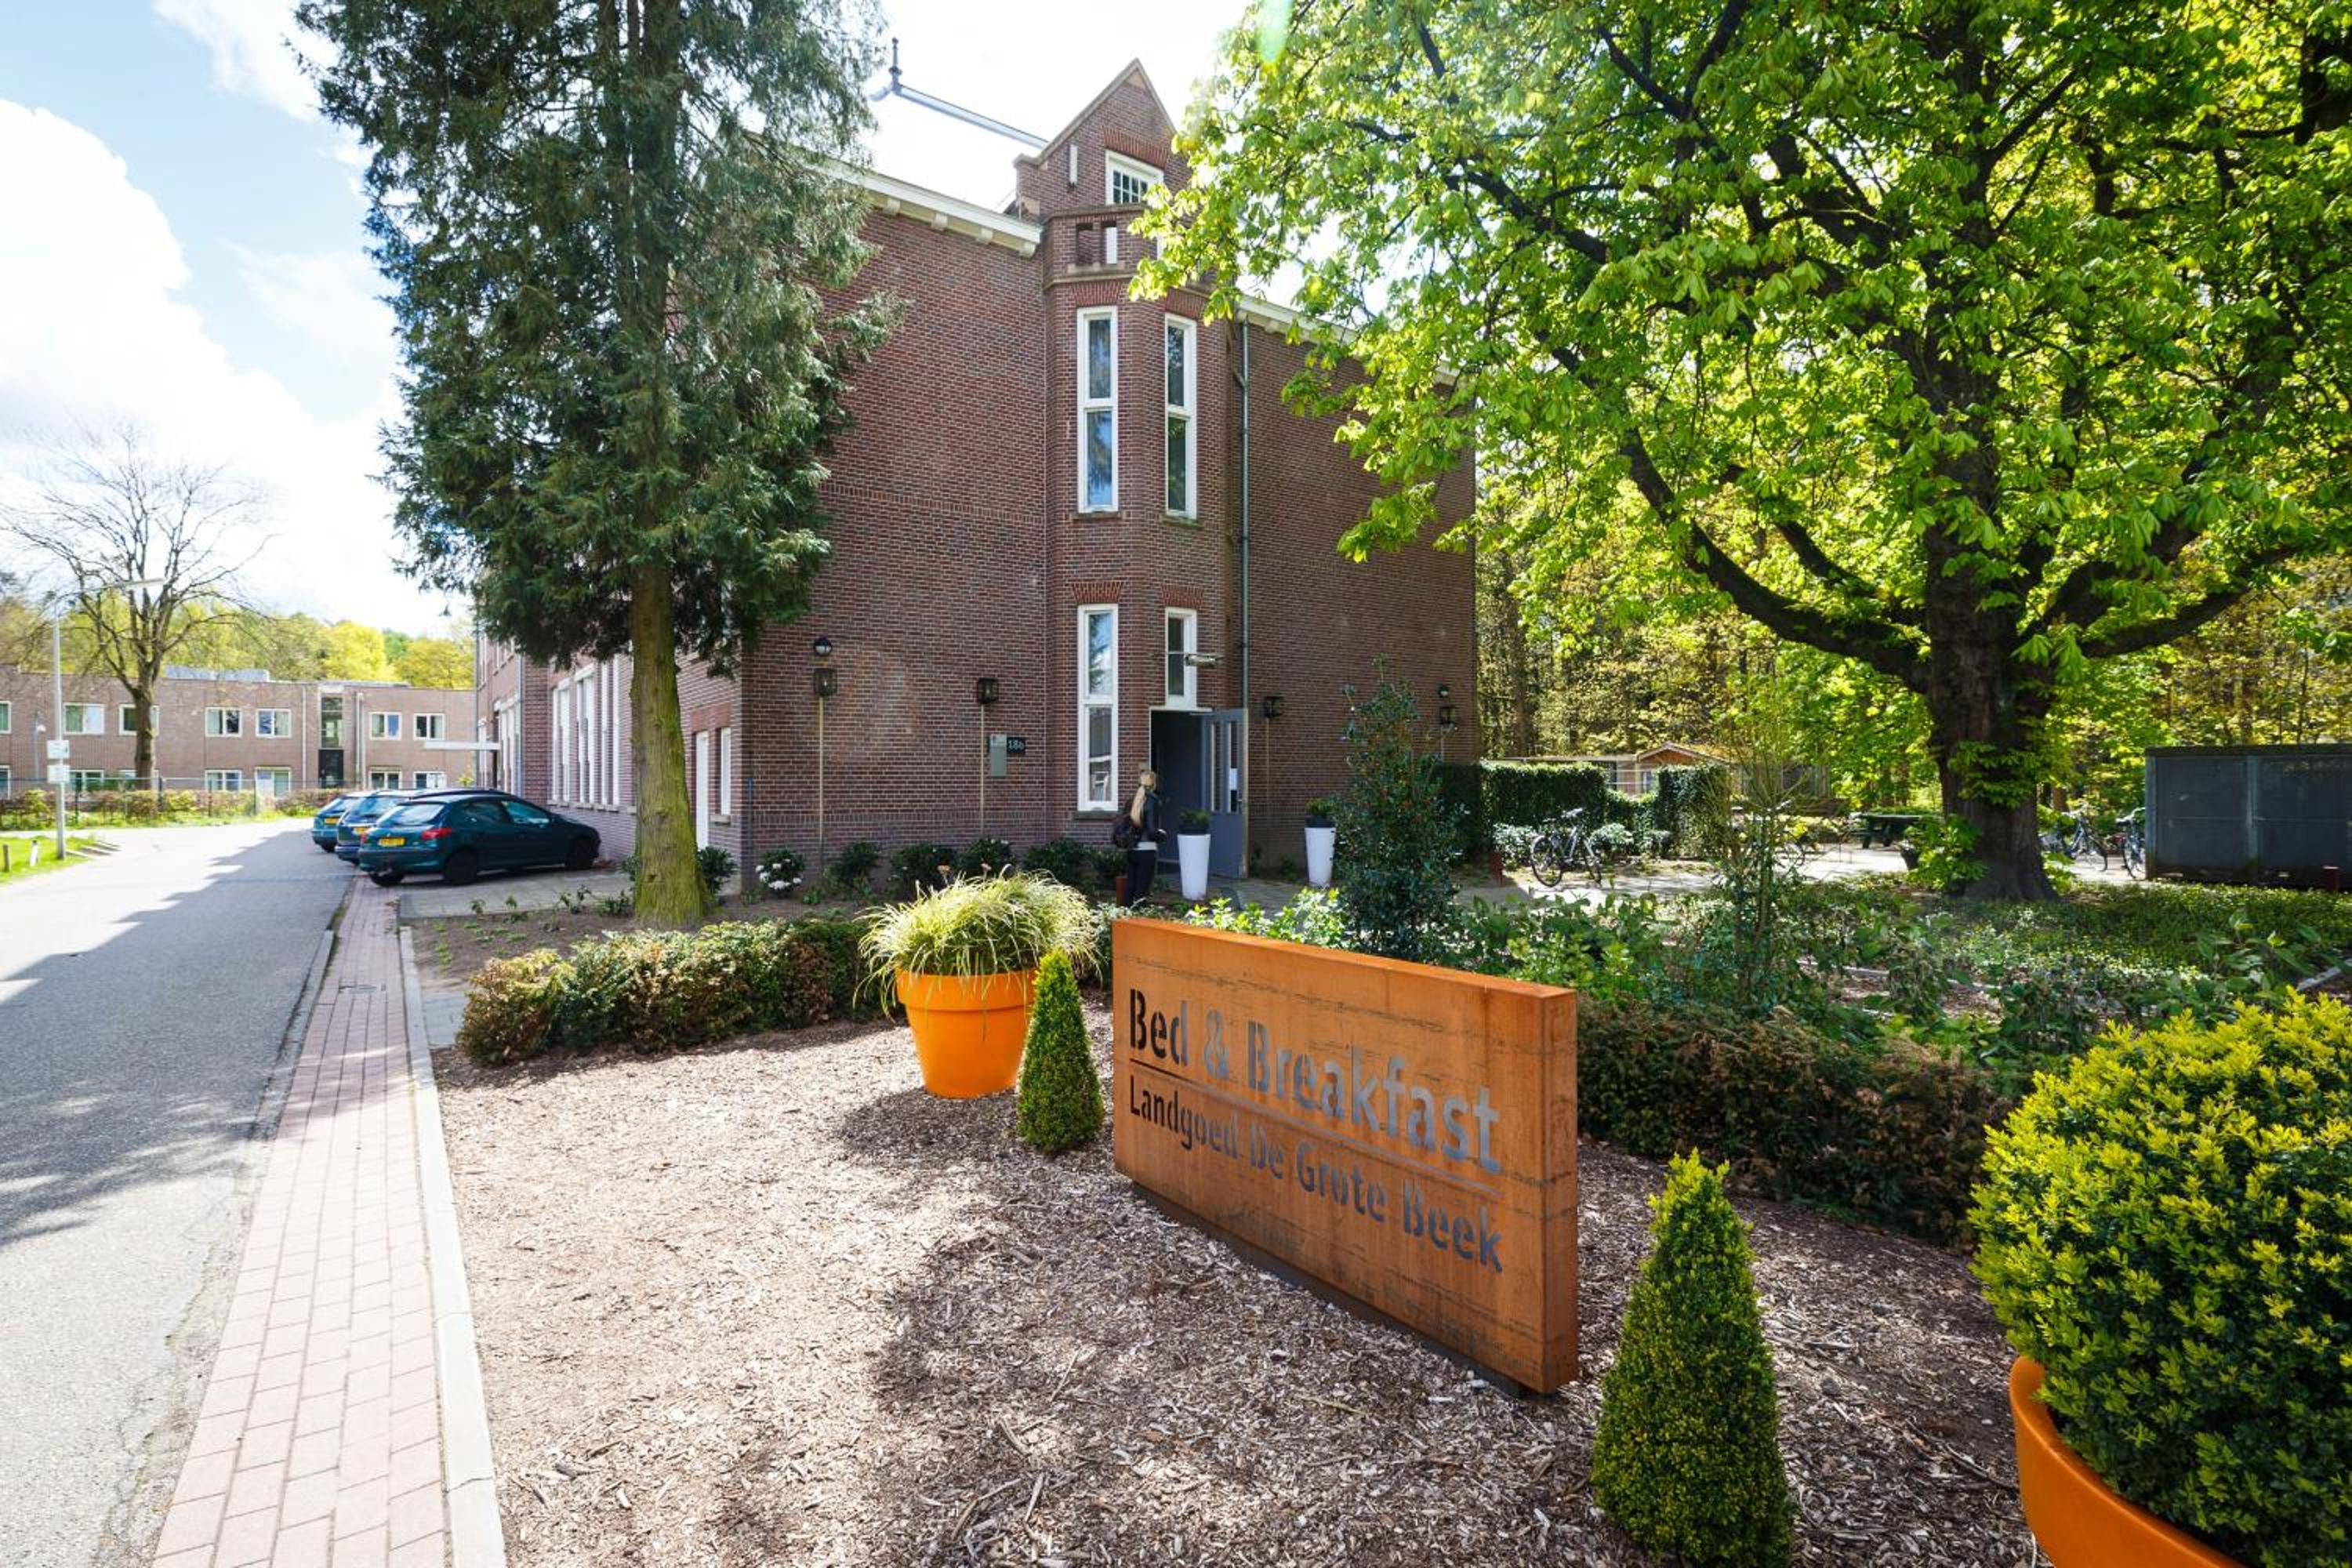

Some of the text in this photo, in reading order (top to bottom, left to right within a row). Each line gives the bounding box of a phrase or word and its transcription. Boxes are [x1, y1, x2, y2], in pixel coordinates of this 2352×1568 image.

[1130, 989, 1501, 1173] Bed & Breakfast
[1130, 1075, 1502, 1273] Landgoed De Grote Beek
